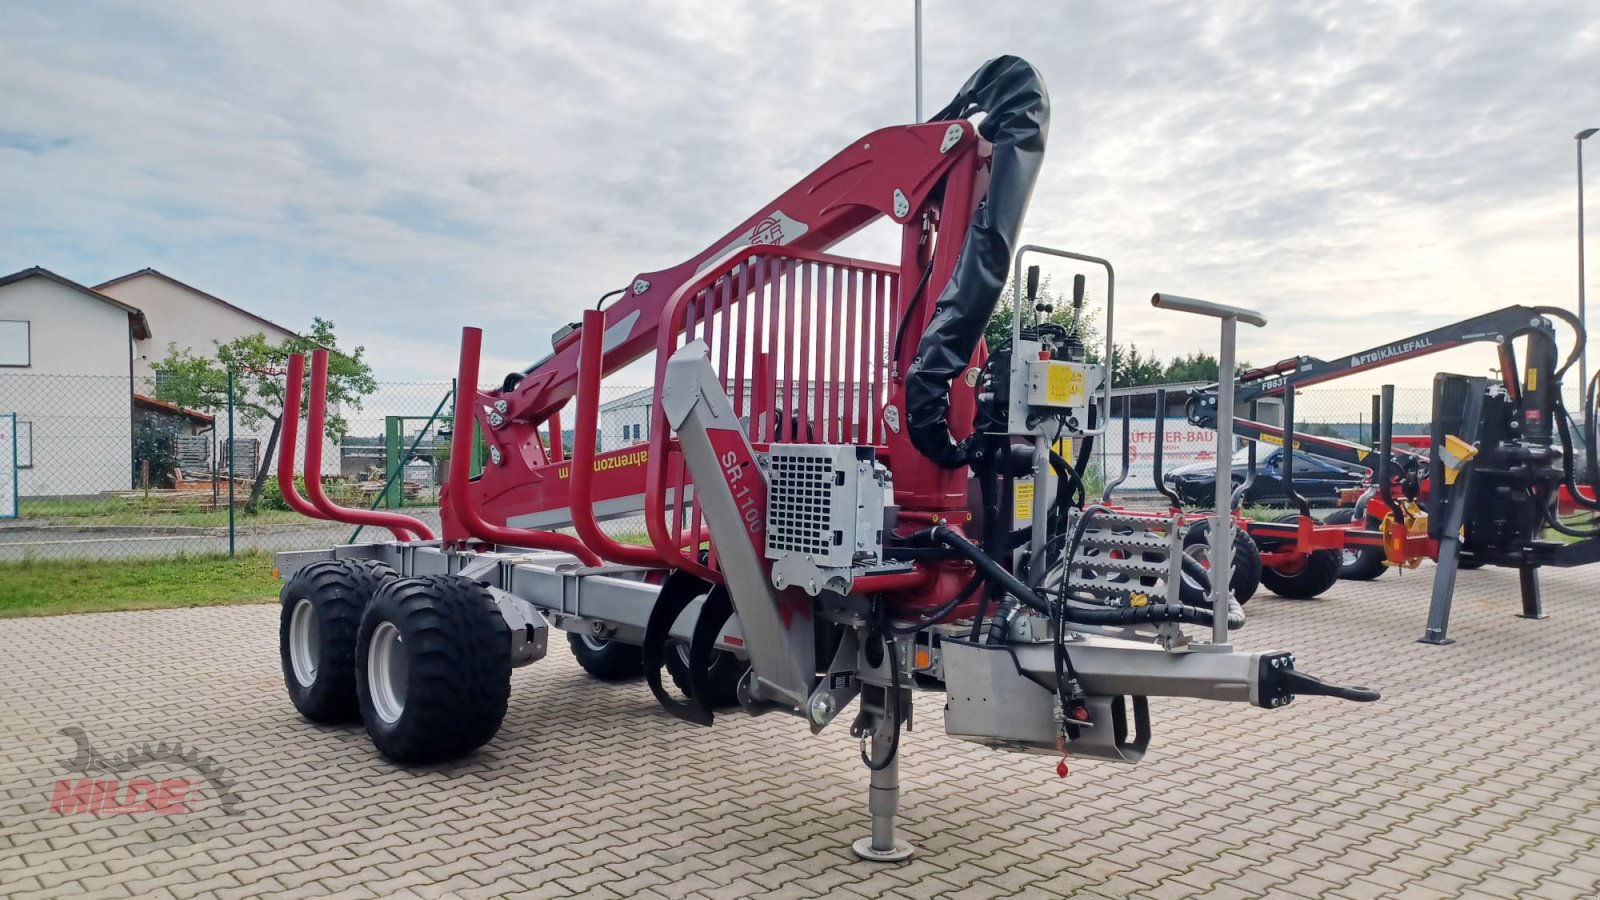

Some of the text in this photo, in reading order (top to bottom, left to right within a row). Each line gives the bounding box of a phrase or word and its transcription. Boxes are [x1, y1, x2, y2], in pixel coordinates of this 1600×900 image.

[1129, 429, 1213, 443] ÜFFER-BAU
[594, 450, 648, 472] ahrenzon
[721, 450, 762, 534] SR.1100
